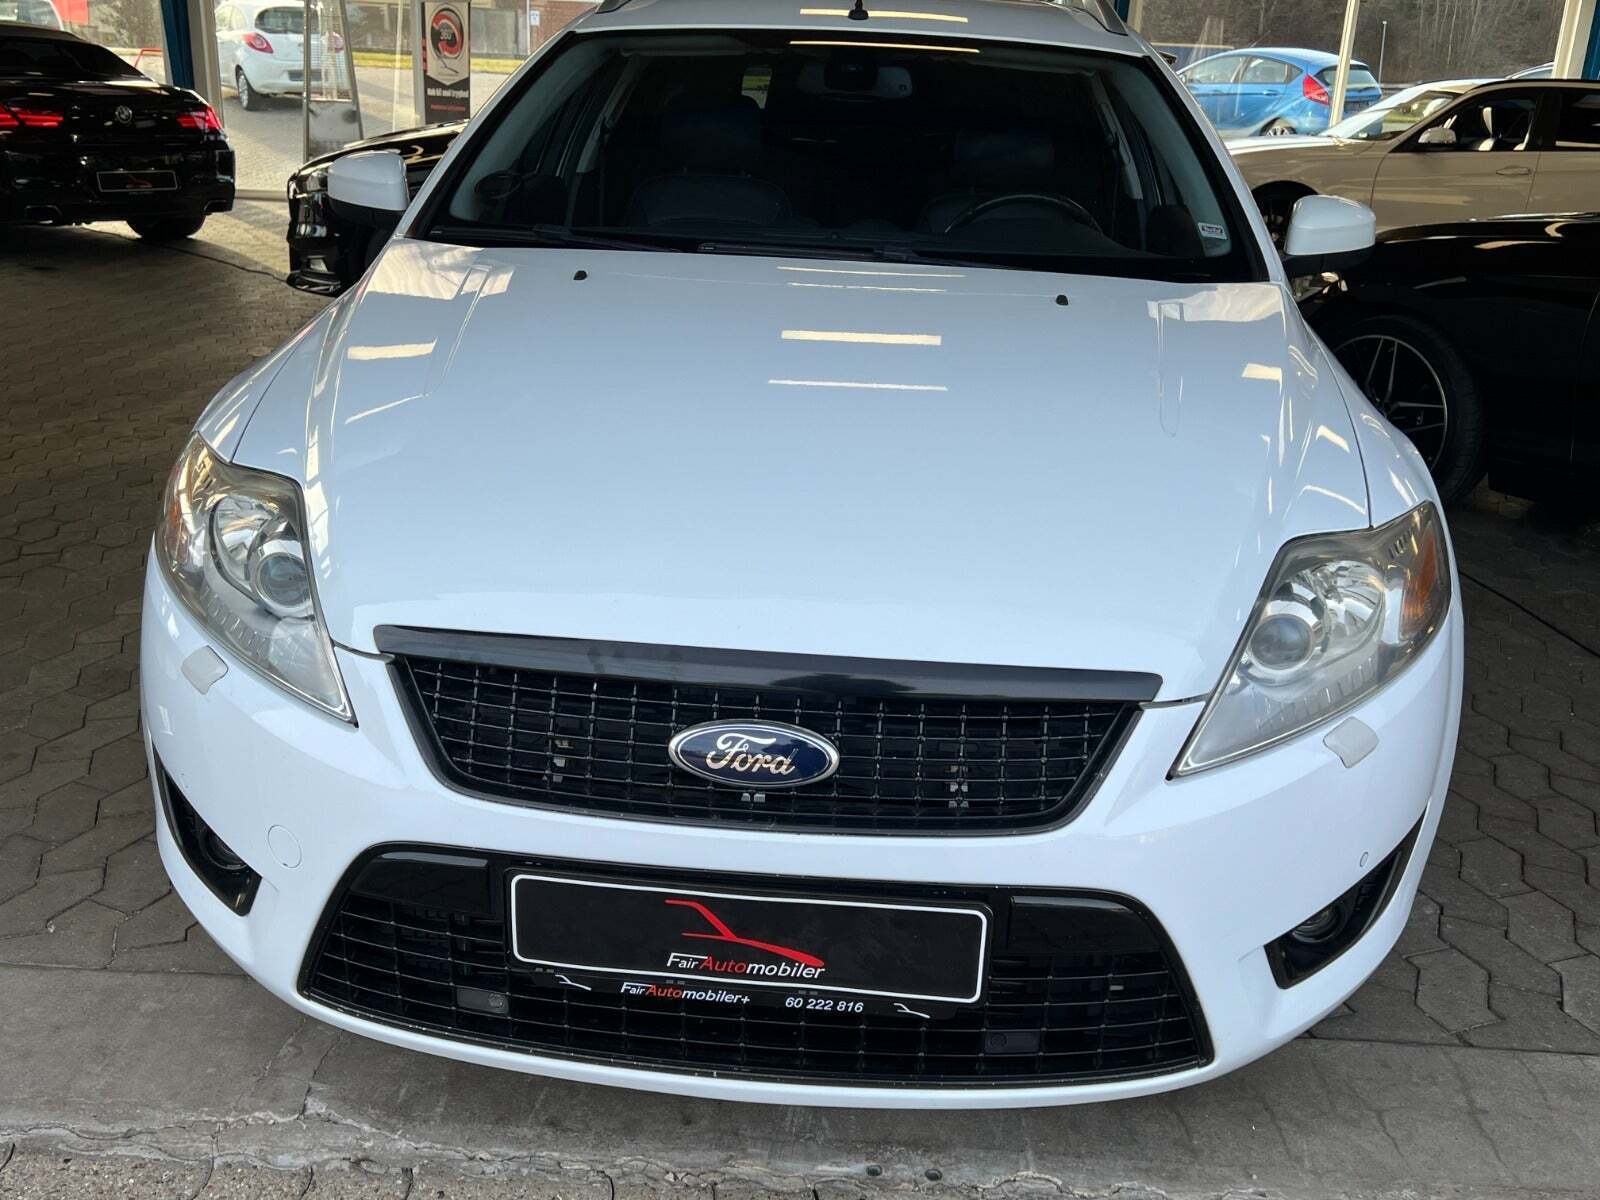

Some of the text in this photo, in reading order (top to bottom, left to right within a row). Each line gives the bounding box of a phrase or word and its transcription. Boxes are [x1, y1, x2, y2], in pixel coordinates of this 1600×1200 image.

[706, 733, 796, 775] Ford
[785, 997, 864, 1013] 60 222 816
